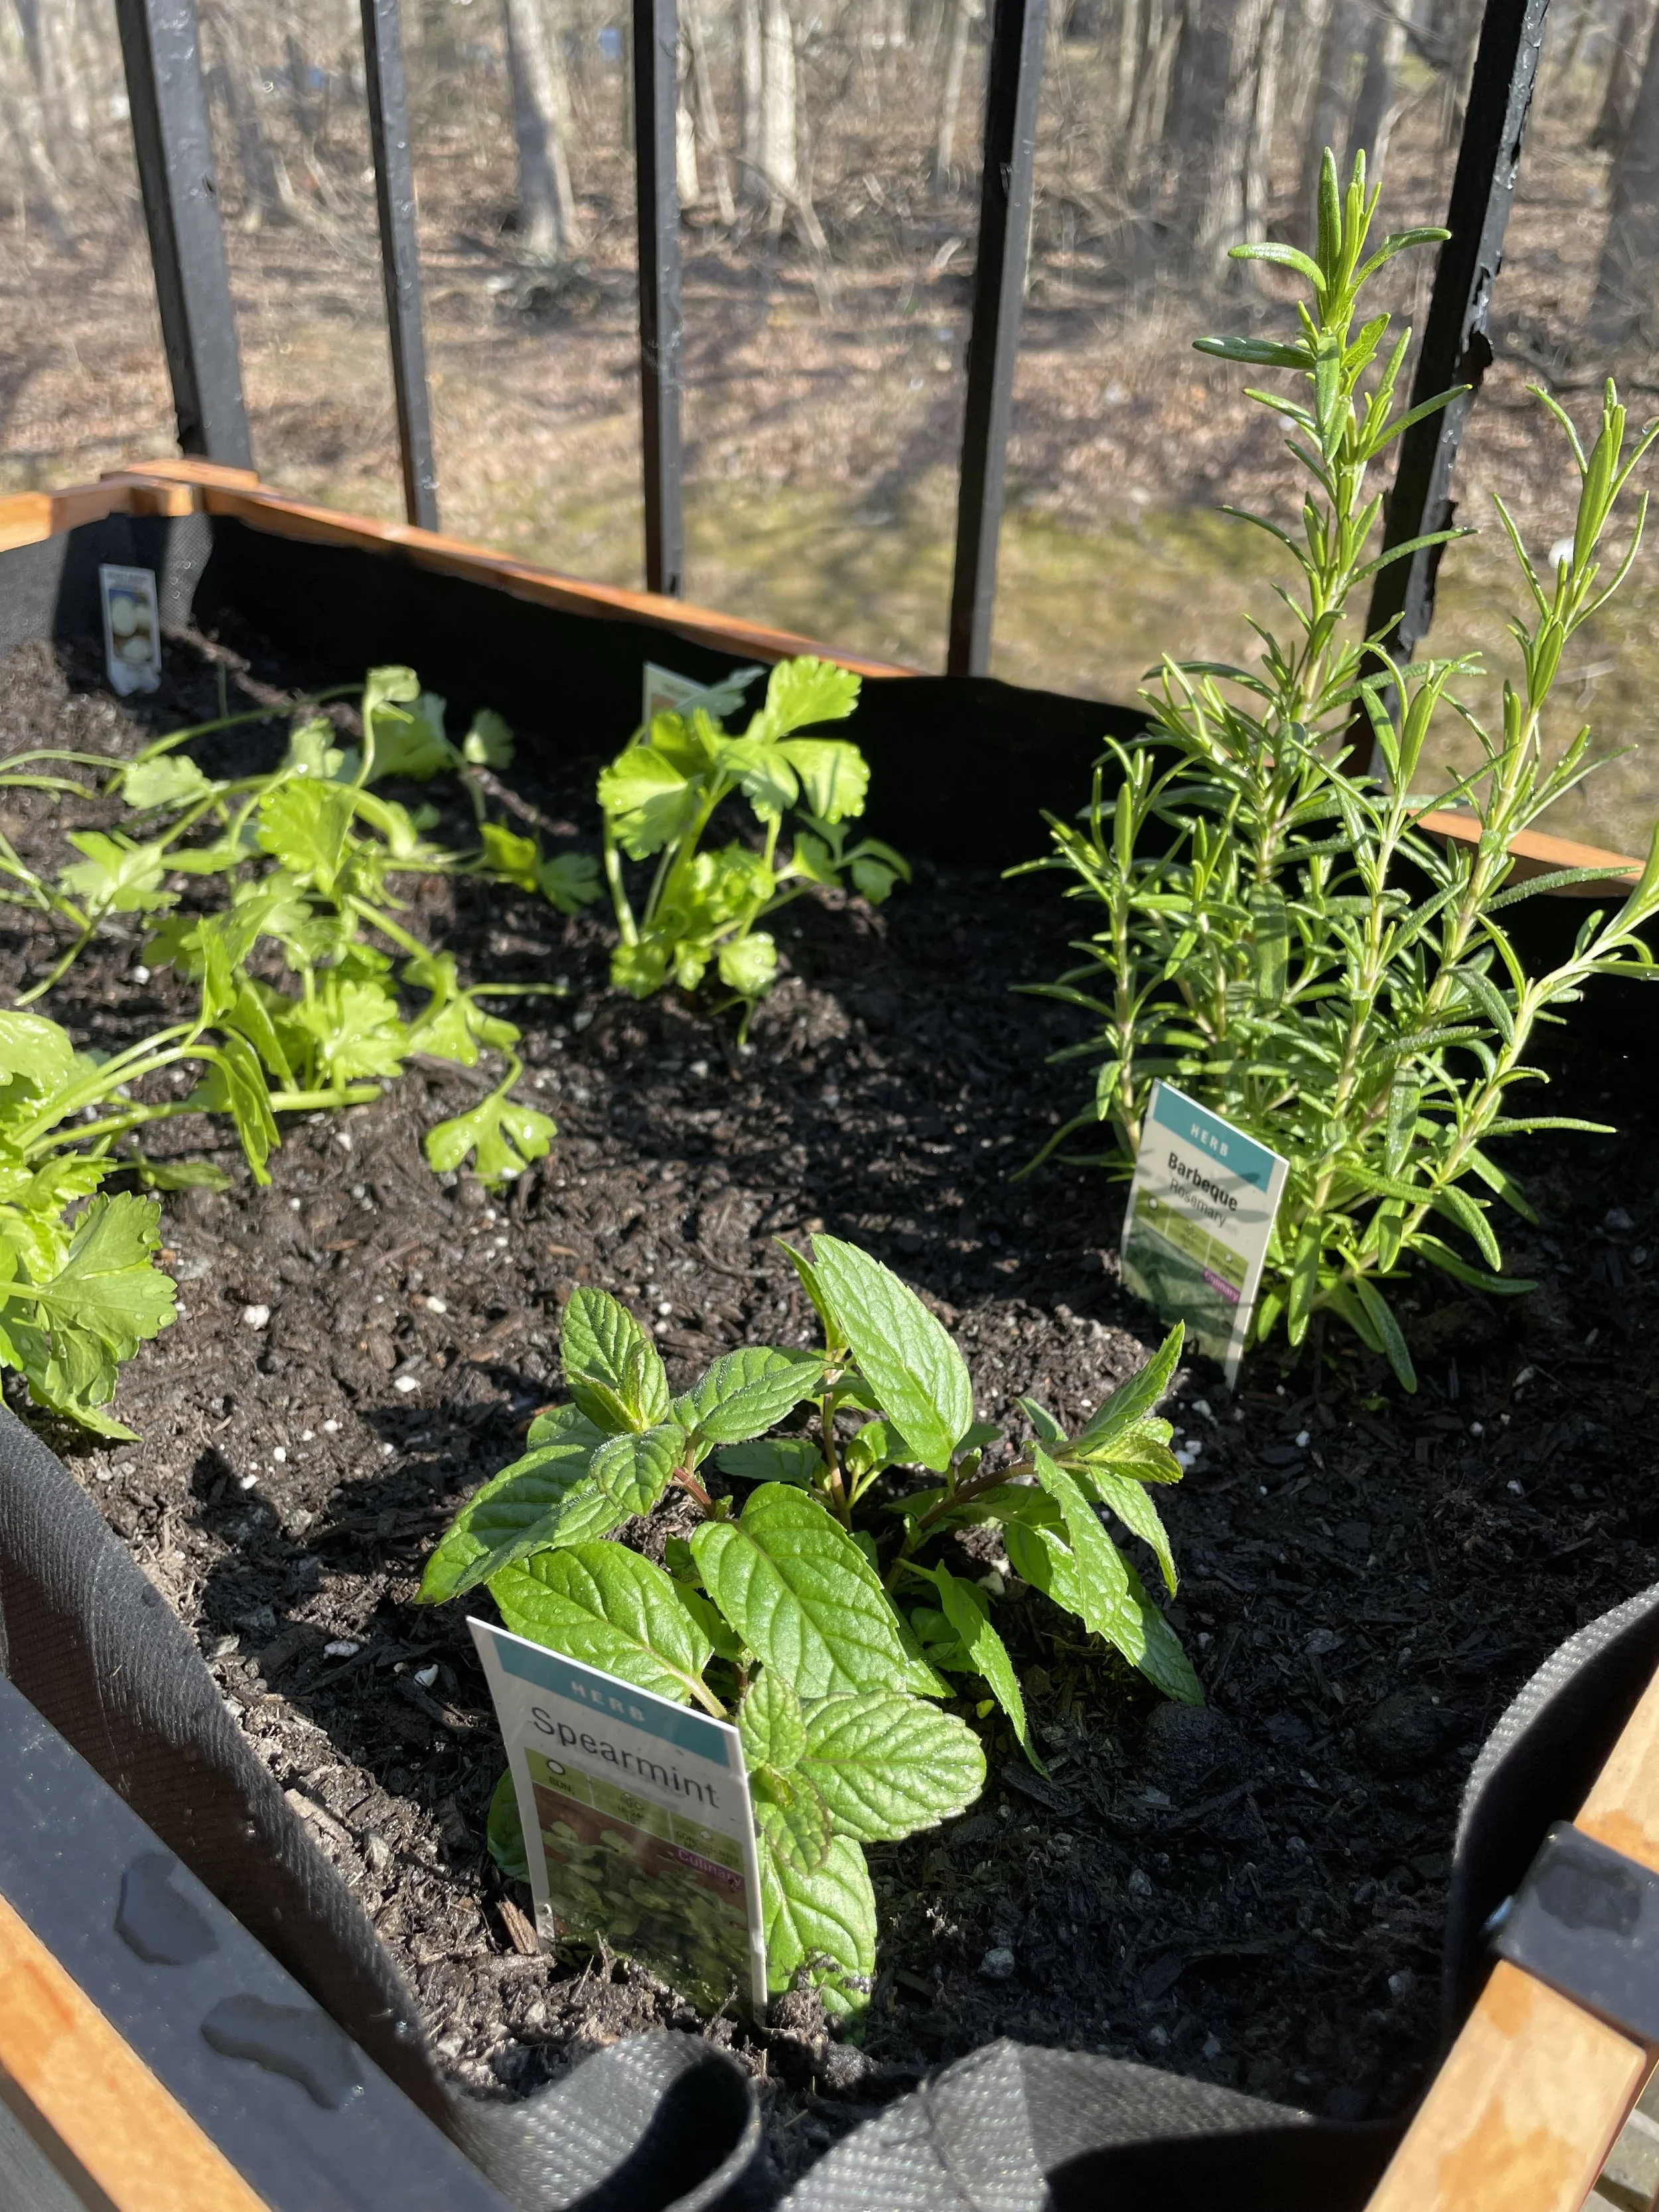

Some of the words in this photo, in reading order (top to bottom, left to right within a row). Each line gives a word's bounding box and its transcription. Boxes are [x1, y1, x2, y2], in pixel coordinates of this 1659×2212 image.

[1190, 1123, 1229, 1157] HERB
[1168, 1151, 1238, 1212] Barbeque
[1169, 1178, 1227, 1227] Rosemary
[1204, 1269, 1240, 1302] Culinary
[570, 1680, 645, 1722] HERB
[532, 1706, 720, 1809] Spearmint
[678, 1849, 743, 1887] Culinary
